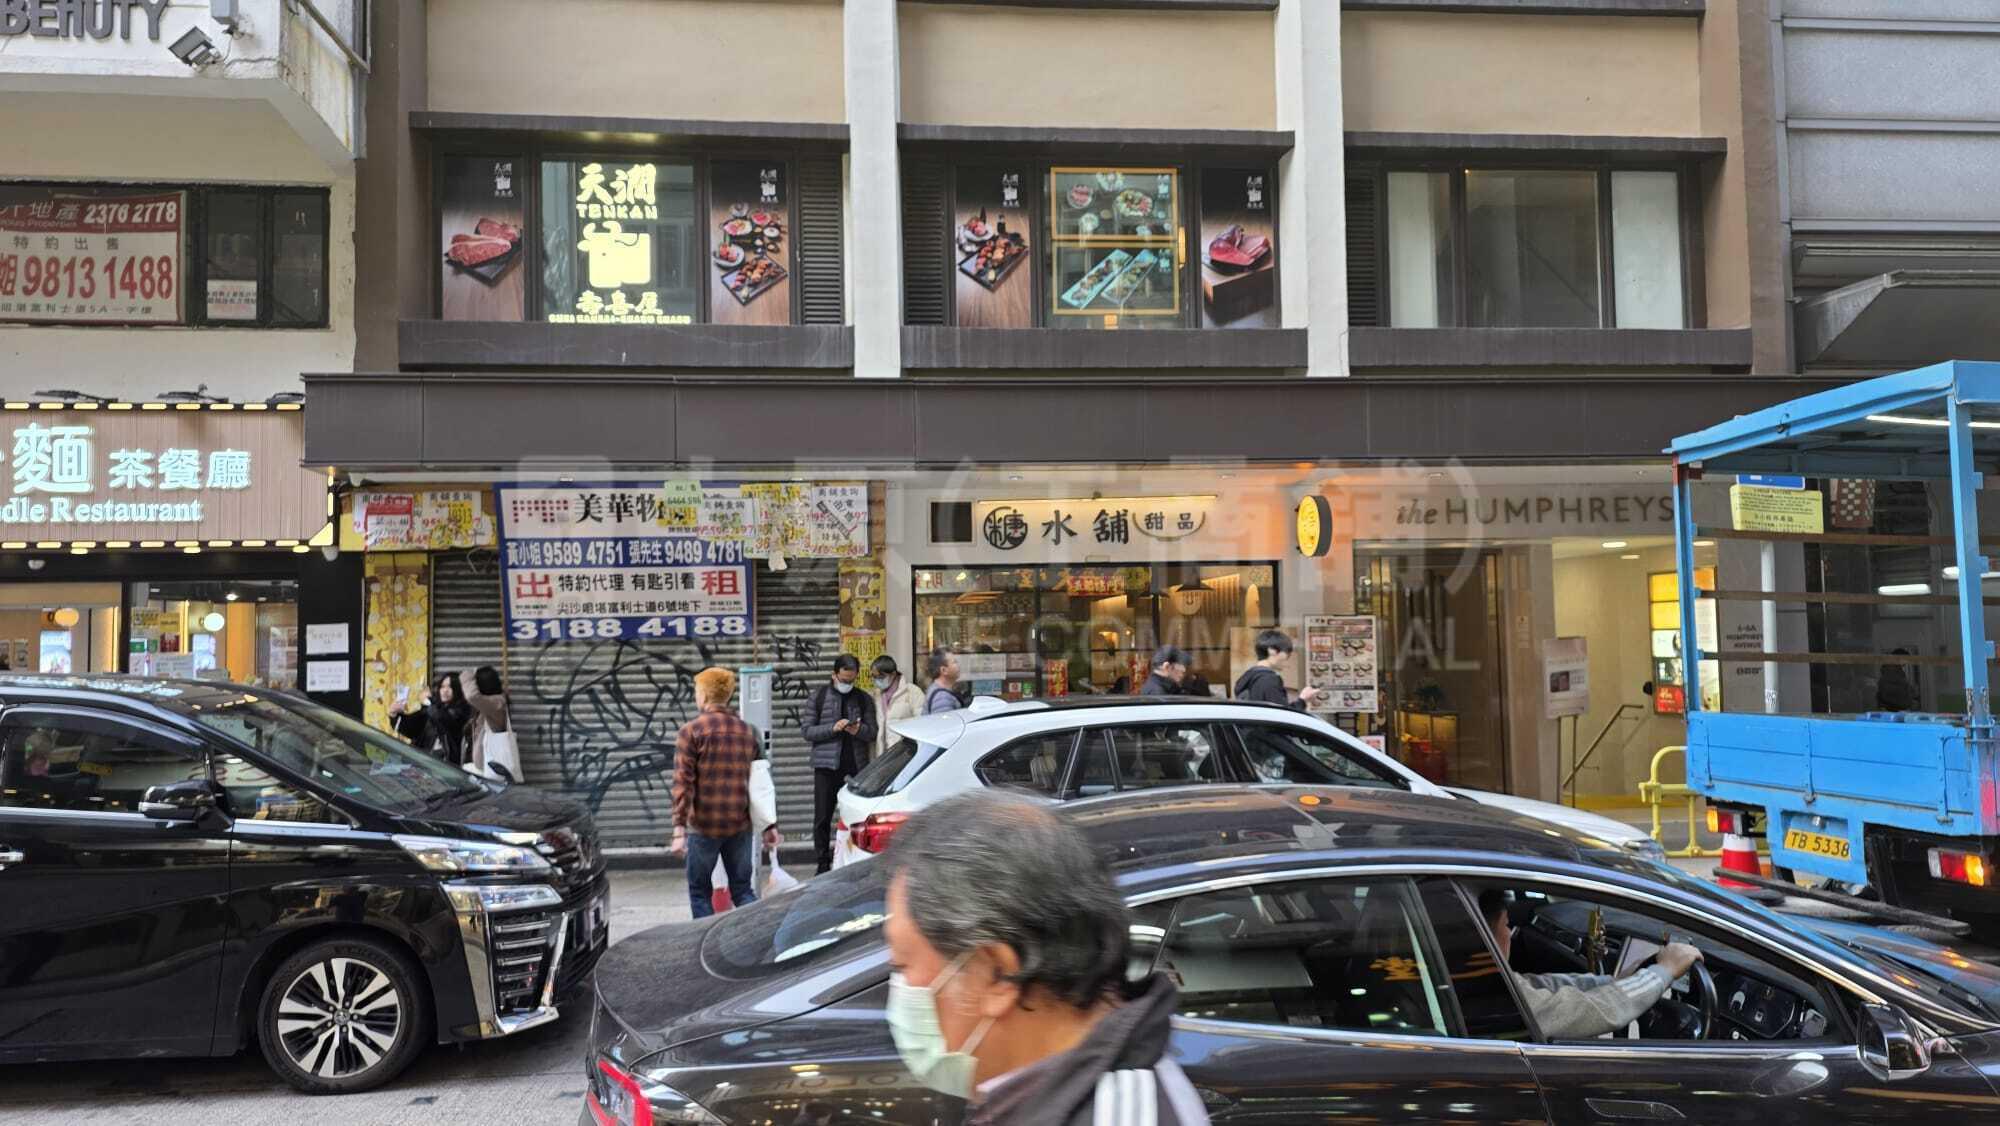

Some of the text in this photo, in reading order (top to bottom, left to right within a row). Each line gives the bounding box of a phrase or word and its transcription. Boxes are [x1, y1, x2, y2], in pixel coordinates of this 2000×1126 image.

[0, 0, 168, 40] BEAUTY
[132, 201, 177, 223] 2778
[576, 203, 658, 219] TENKAN
[22, 255, 97, 299] 9813
[103, 255, 173, 300] 1488
[108, 448, 251, 489] 茶餐廳
[50, 497, 203, 523] Restaurant
[575, 493, 668, 524] 美華物
[1144, 511, 1194, 531] 甜品
[1396, 496, 1675, 524] the HUMPHREYS
[543, 541, 582, 565] 9589
[586, 541, 623, 564] 4751
[664, 540, 703, 564] 9489
[706, 540, 744, 563] 4781
[515, 569, 741, 599] 出 特約代理 有匙引看 租
[511, 616, 747, 640] 3188 4188
[1791, 831, 1850, 857] TB 5338
